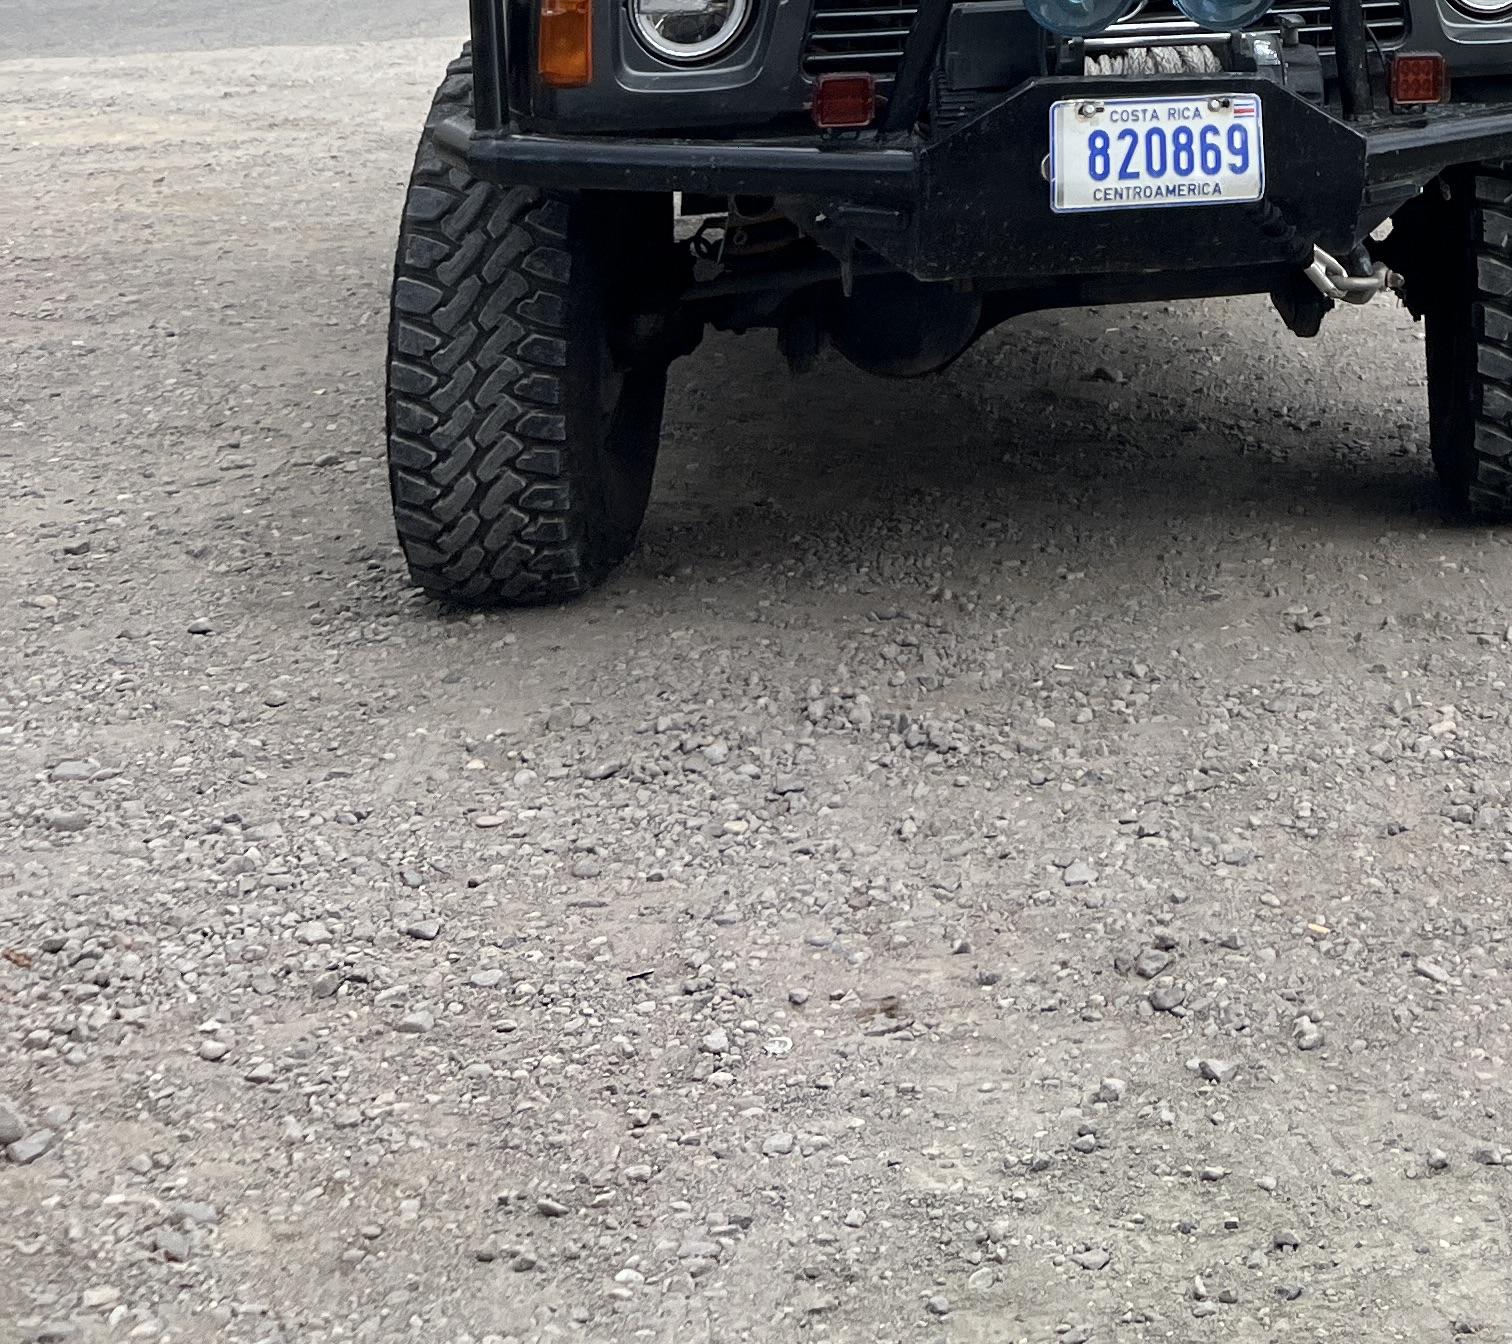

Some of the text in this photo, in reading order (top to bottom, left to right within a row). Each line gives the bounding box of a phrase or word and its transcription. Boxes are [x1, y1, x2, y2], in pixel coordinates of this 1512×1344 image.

[1109, 105, 1203, 124] COSTA RICA
[1087, 123, 1251, 183] 820869
[1092, 181, 1223, 202] CENTROAMERICA
